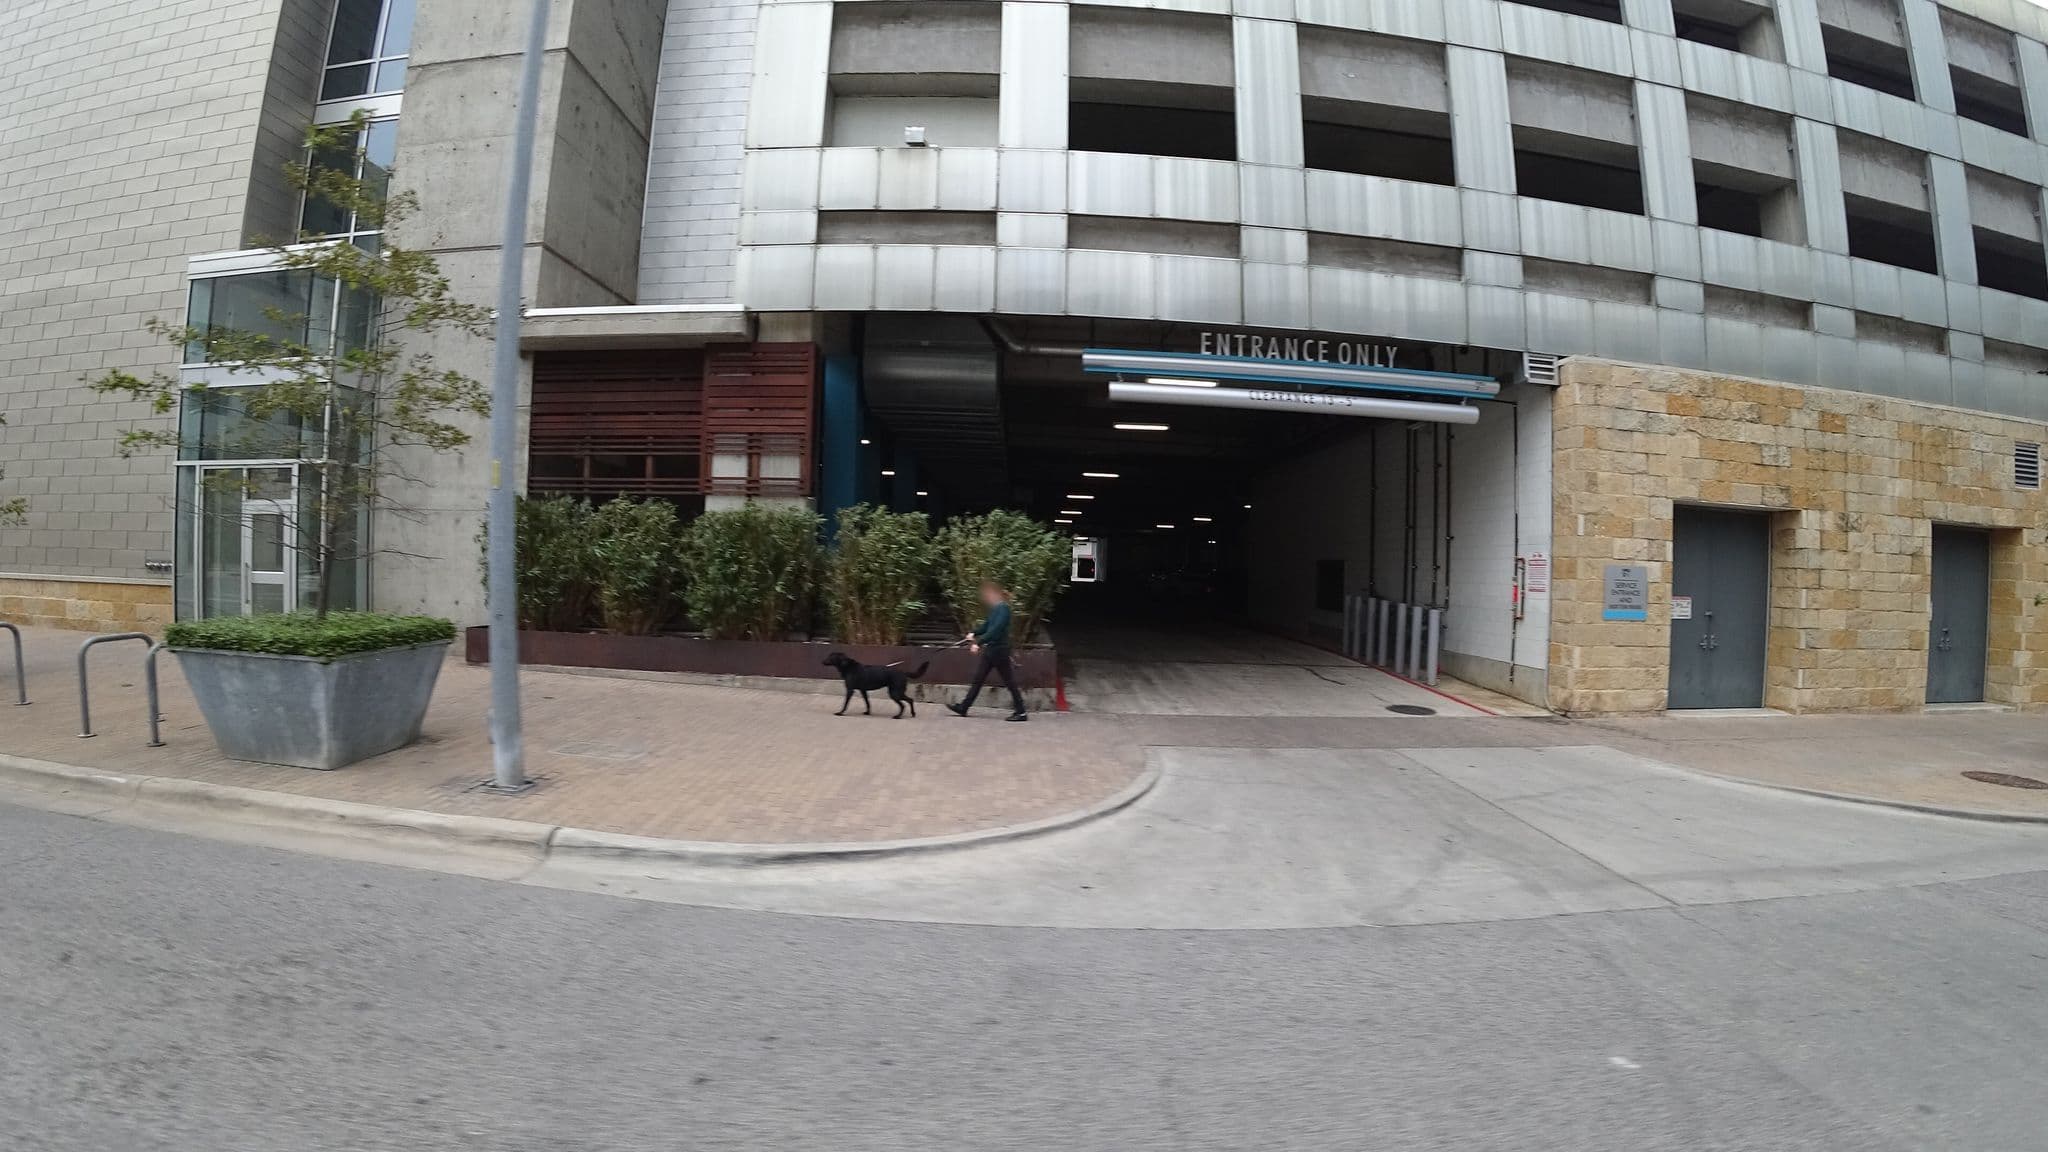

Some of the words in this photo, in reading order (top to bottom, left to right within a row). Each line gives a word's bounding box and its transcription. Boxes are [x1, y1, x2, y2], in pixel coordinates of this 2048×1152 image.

[1200, 332, 1329, 363] ENTRANCE
[1337, 342, 1398, 368] ONLY
[1249, 390, 1315, 404] CLEARANCE
